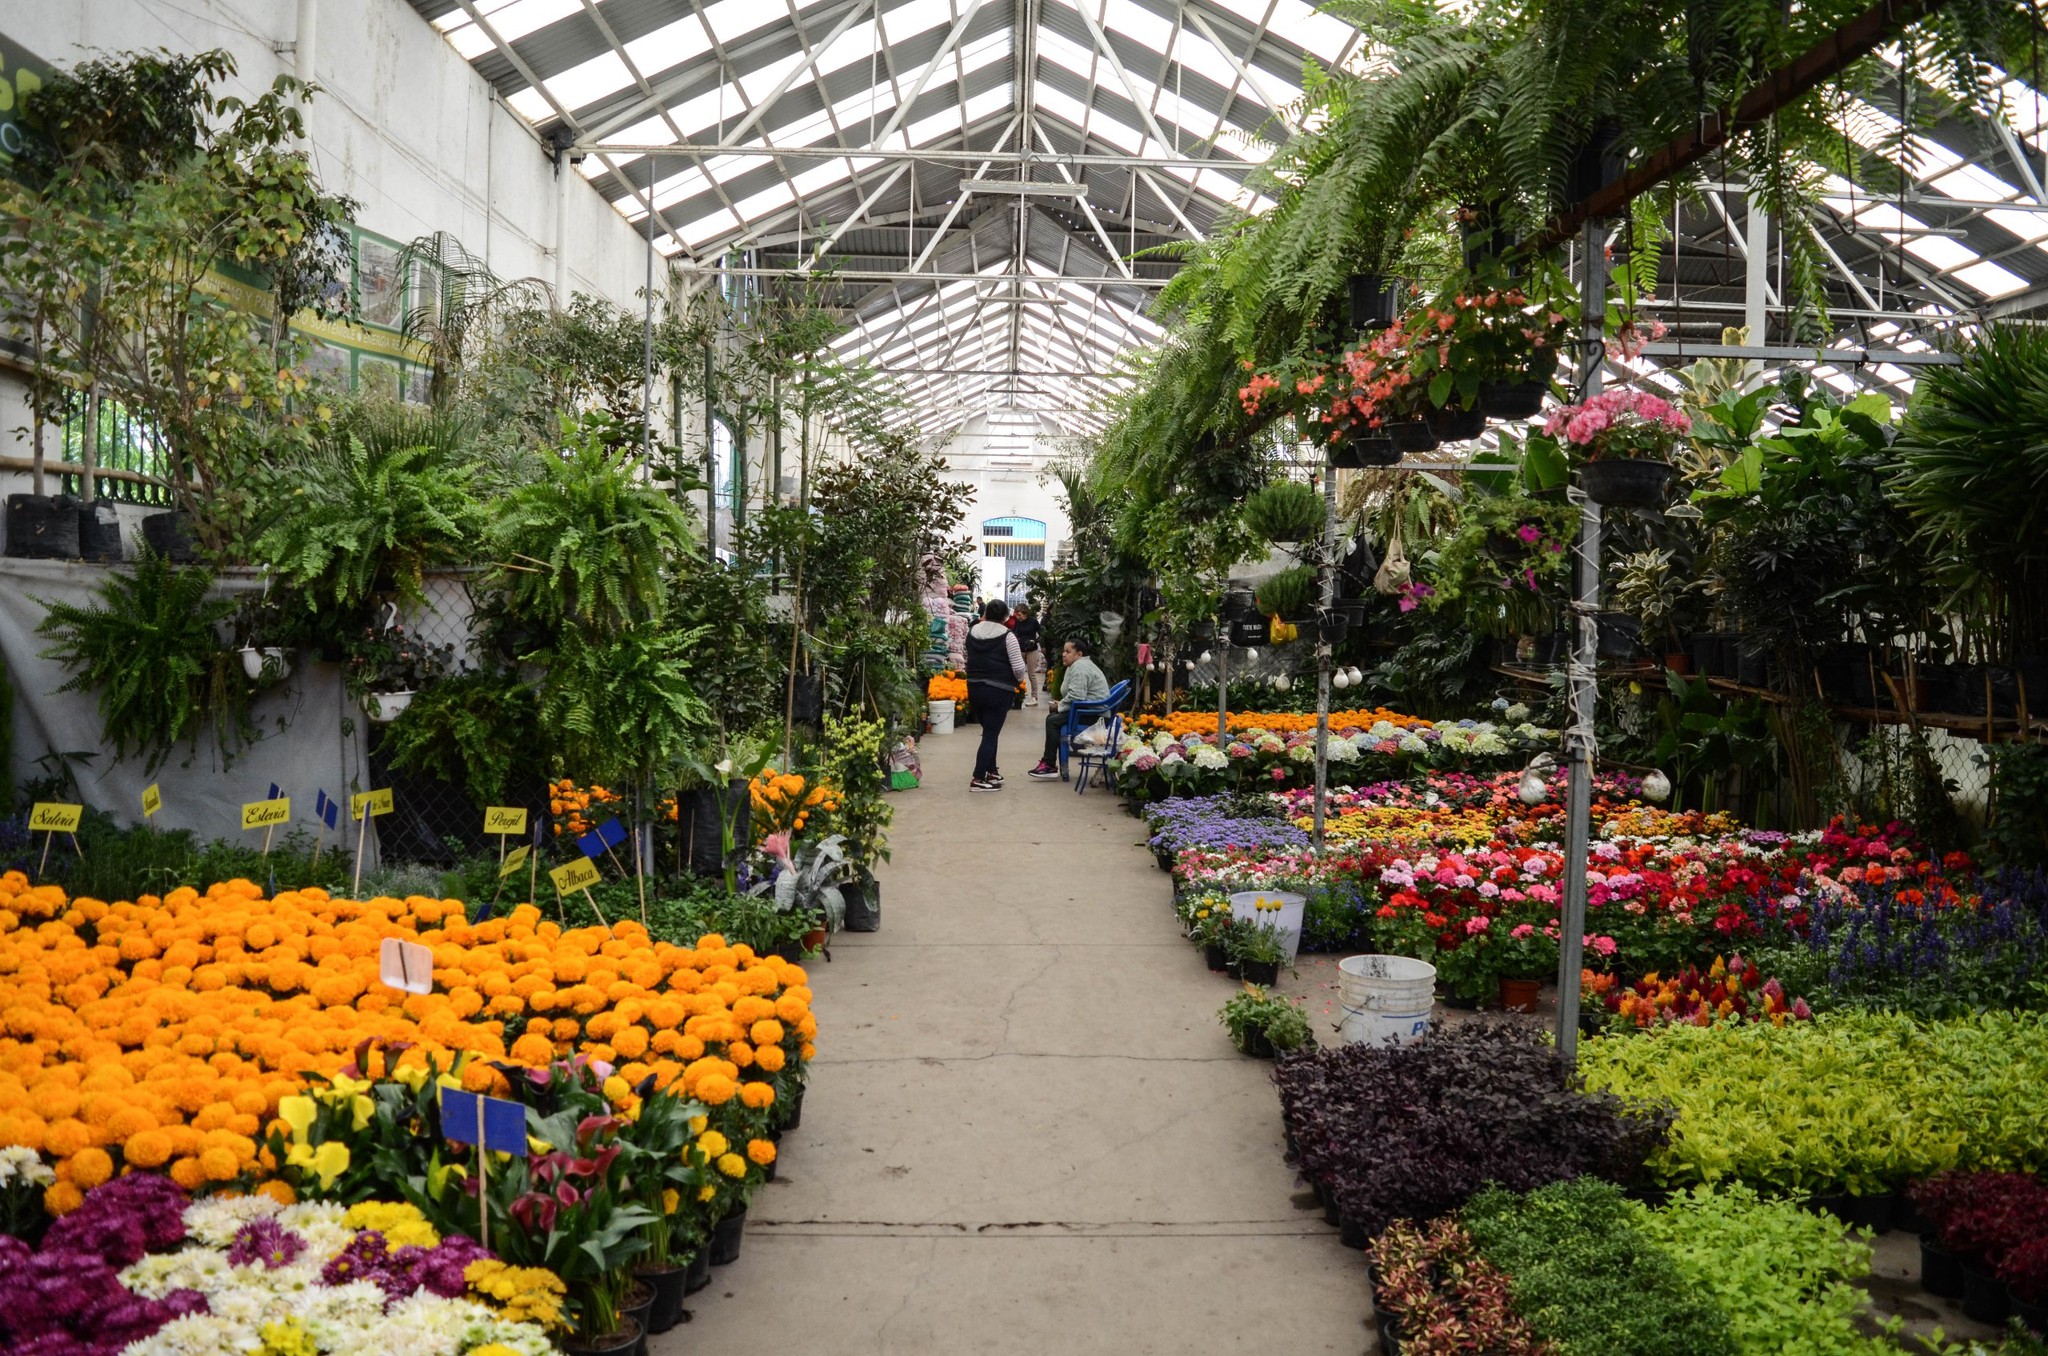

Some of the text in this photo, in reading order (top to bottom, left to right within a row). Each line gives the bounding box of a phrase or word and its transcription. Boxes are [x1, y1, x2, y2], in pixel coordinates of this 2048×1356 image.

[310, 314, 356, 341] SUSTENIBLE
[33, 808, 75, 827] Salvia
[245, 806, 286, 824] Estevia
[558, 869, 594, 890] Albaca
